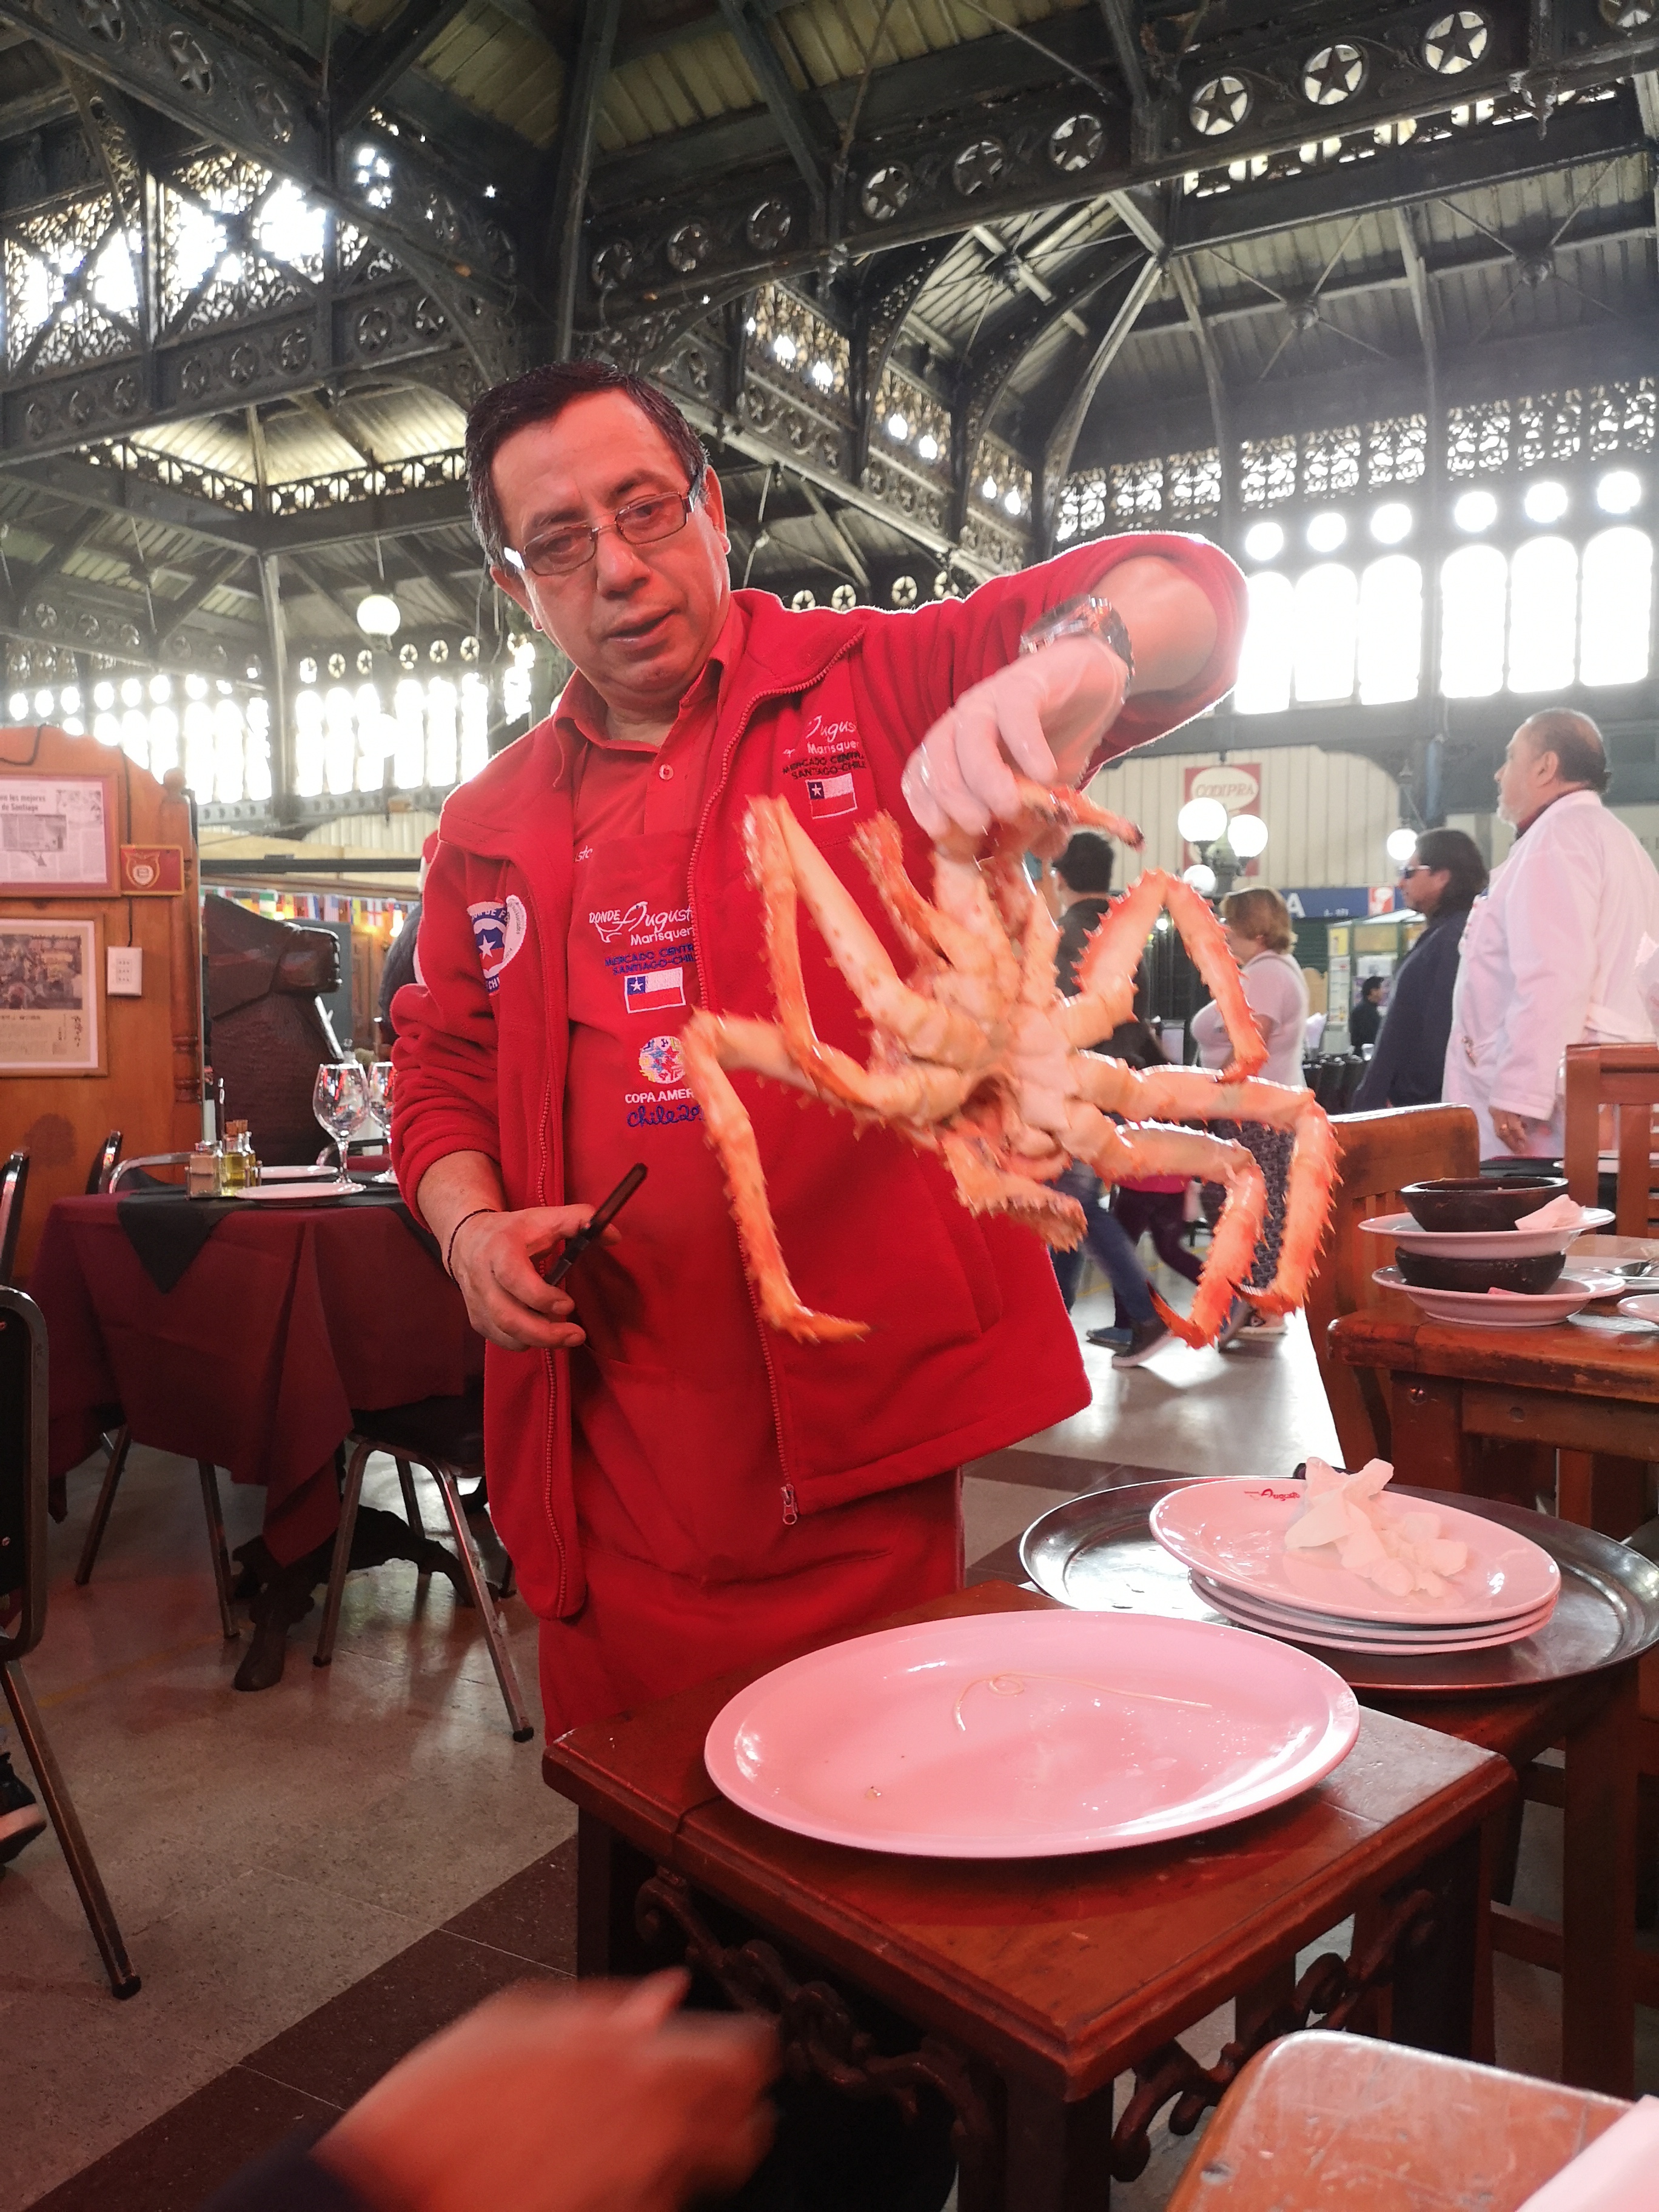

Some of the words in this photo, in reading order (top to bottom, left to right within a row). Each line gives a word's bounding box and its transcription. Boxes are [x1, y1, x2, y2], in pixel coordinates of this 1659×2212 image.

[11, 803, 38, 813] Santiago
[589, 910, 621, 923] DONDE
[605, 951, 655, 967] MERCADO
[625, 1091, 656, 1104] COPA
